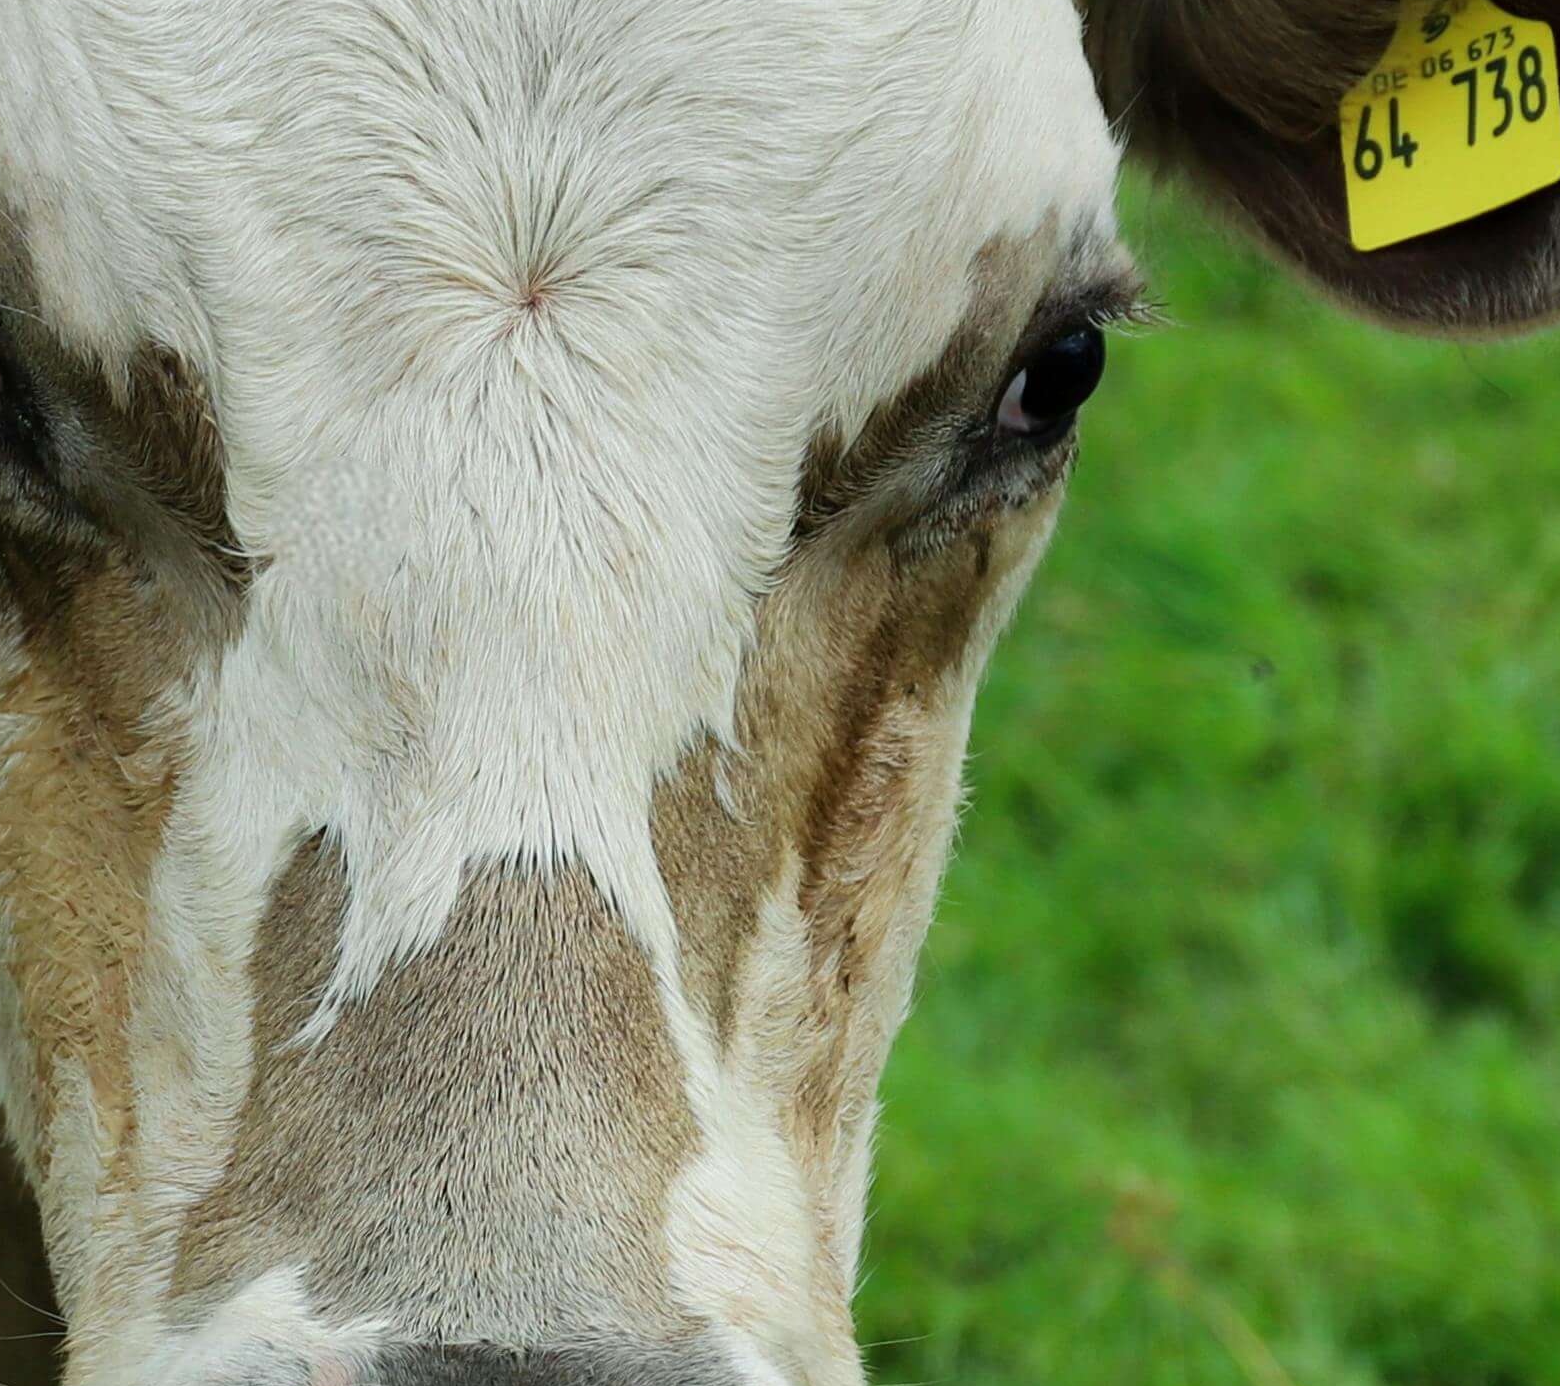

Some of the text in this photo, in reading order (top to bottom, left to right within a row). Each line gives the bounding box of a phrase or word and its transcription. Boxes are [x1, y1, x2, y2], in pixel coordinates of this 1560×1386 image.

[1468, 25, 1515, 61] 673
[1354, 46, 1547, 180] 64 738
